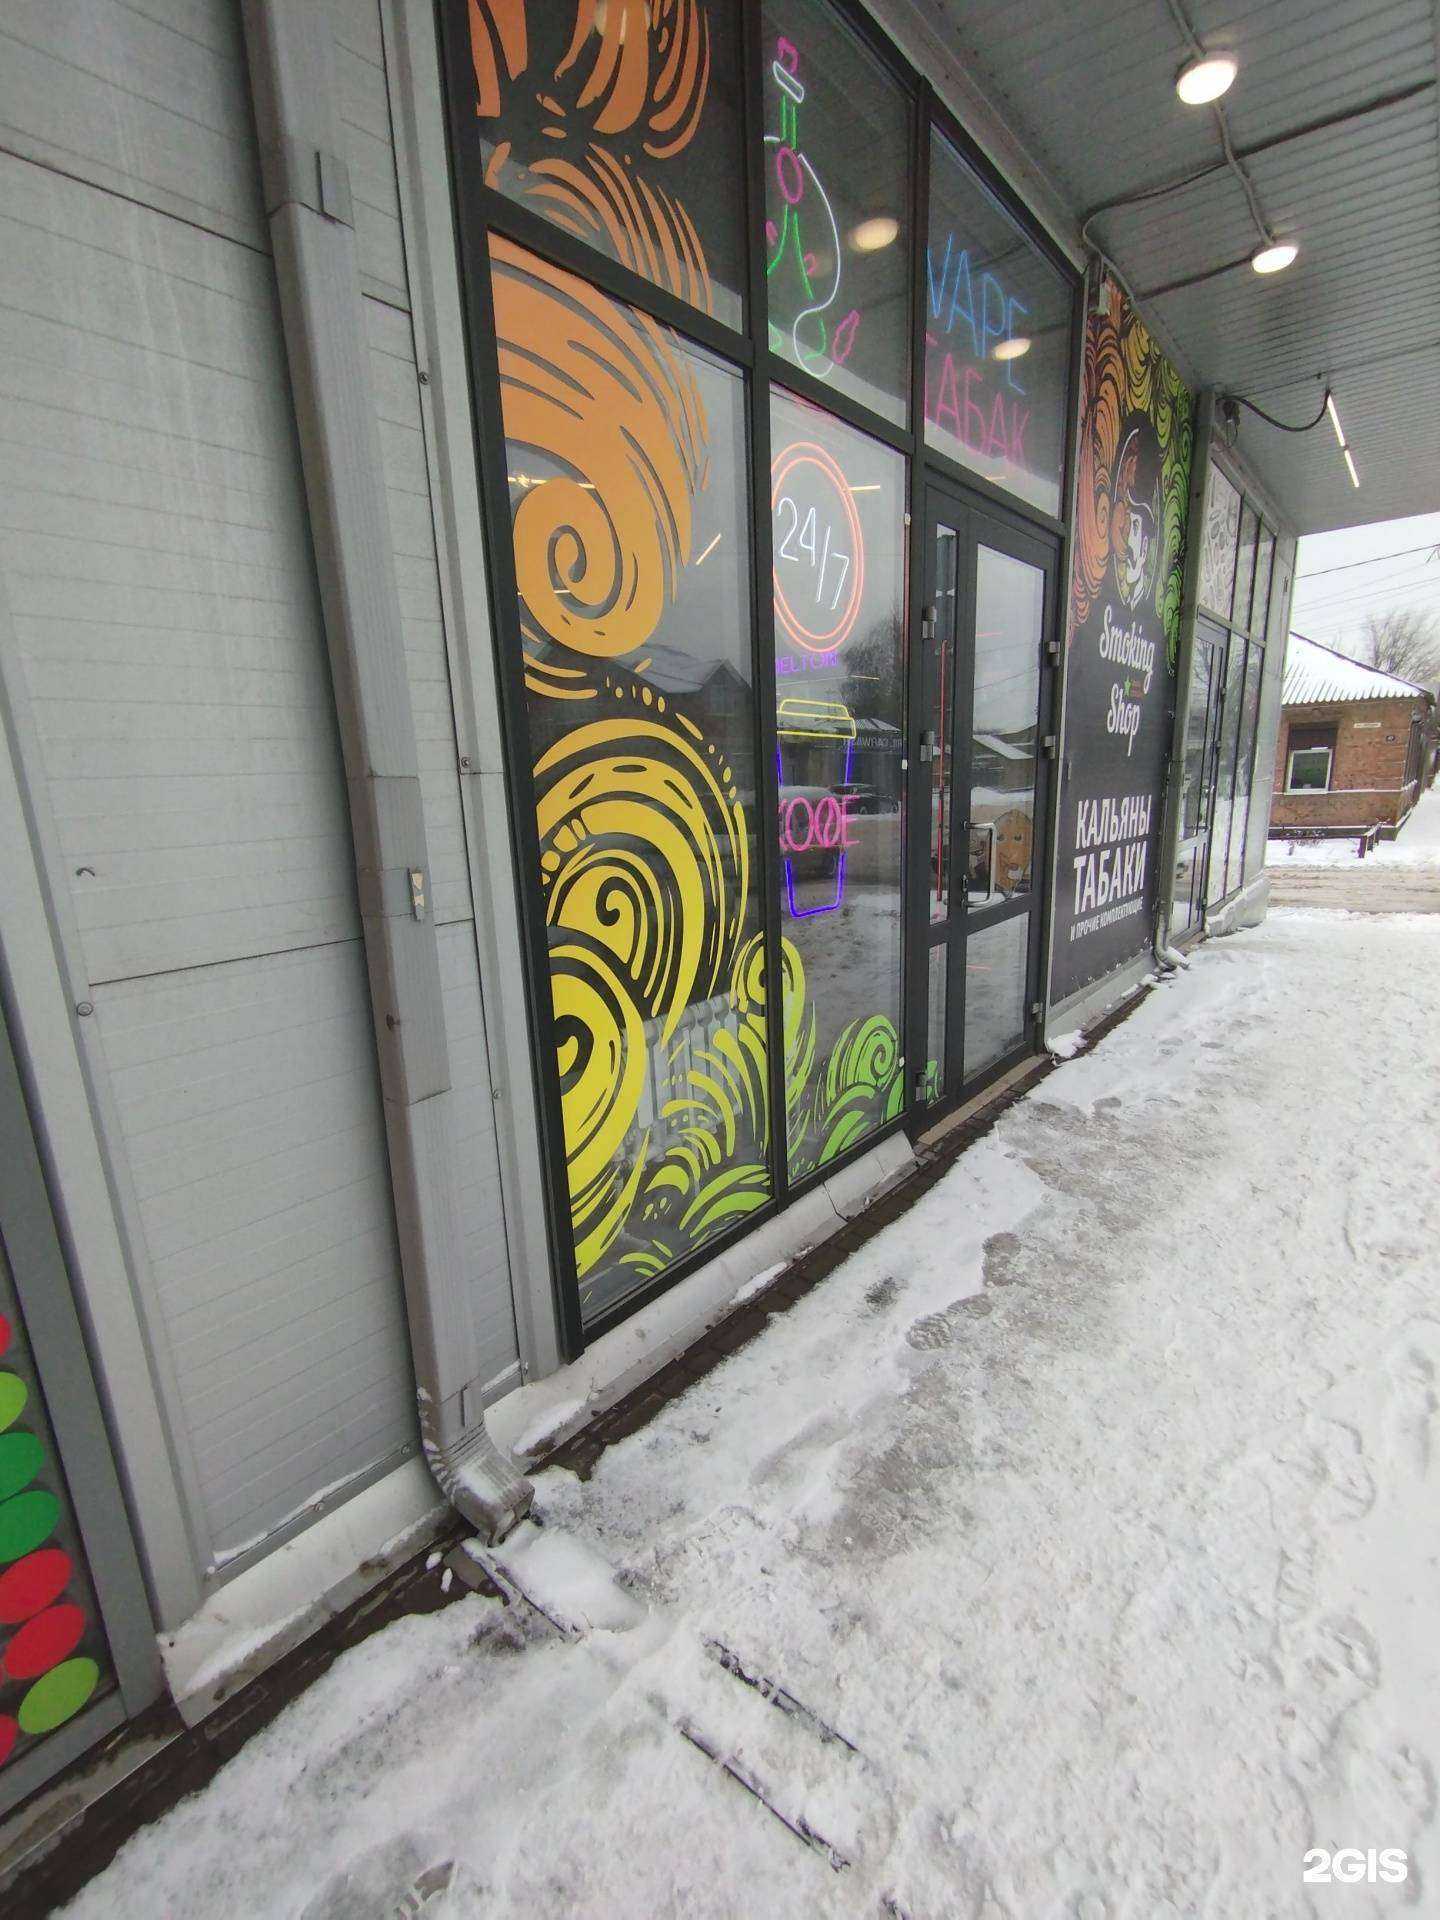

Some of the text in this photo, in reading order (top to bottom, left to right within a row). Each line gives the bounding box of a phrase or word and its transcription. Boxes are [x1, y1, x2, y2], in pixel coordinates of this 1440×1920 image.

[926, 231, 1030, 396] VAPE
[777, 497, 849, 610] 24/7
[1100, 604, 1156, 695] Smoking
[1106, 683, 1140, 757] Shop
[1075, 795, 1152, 849] КАЛЬЯНЫ
[1073, 841, 1147, 915] ТАБАКИ
